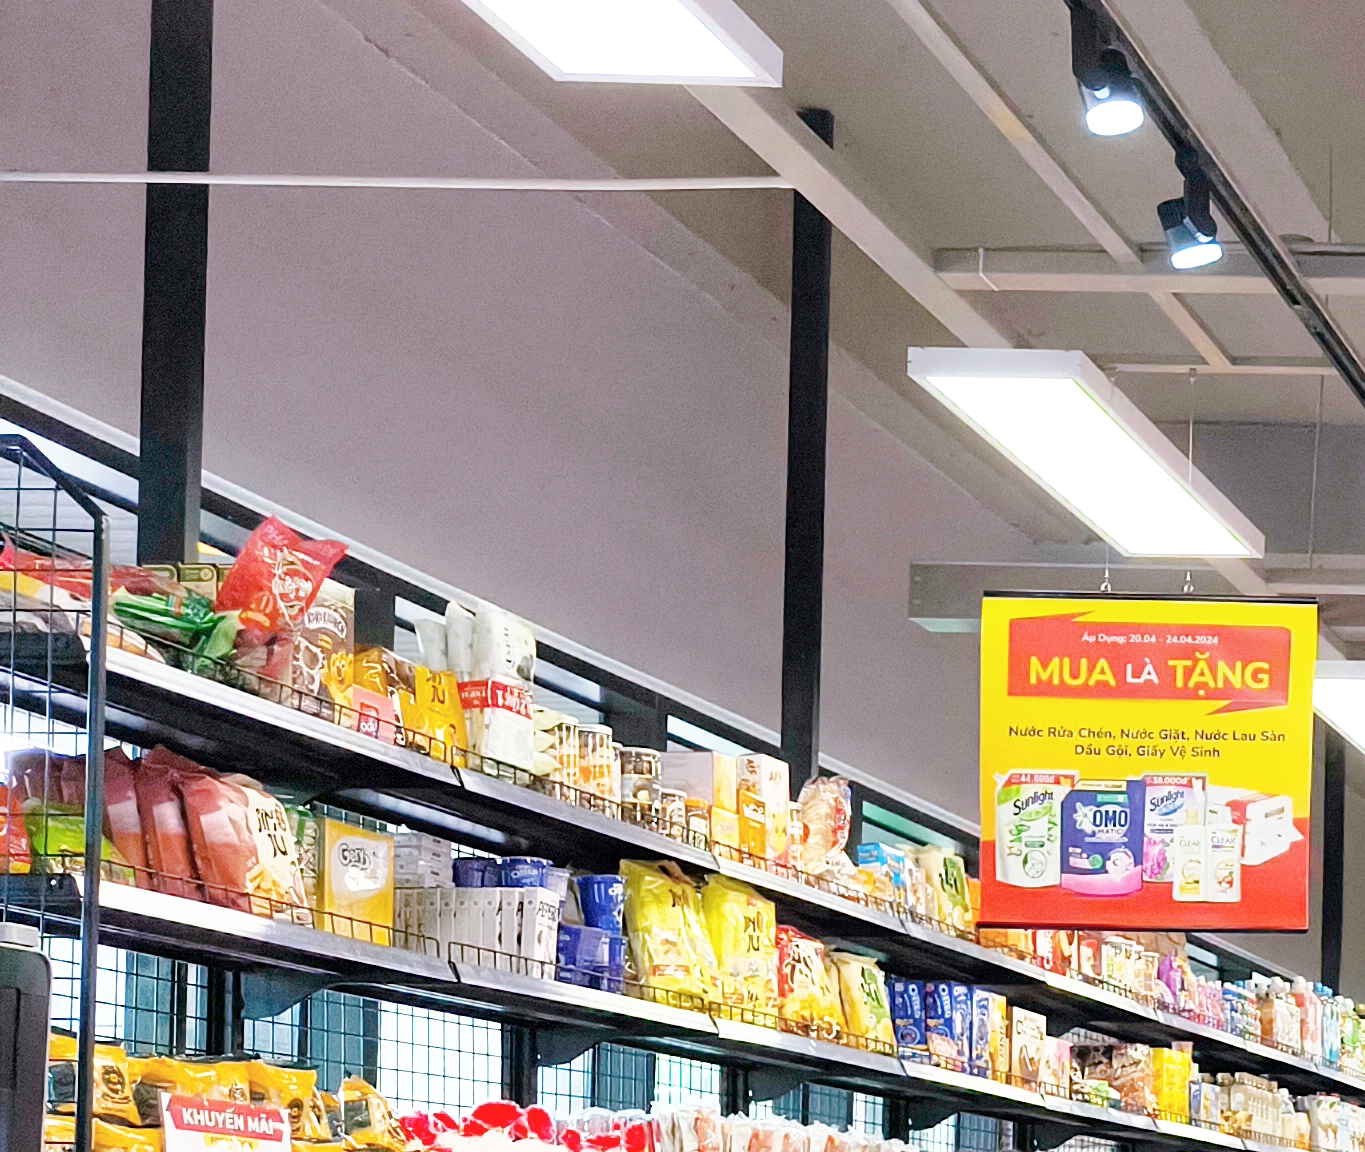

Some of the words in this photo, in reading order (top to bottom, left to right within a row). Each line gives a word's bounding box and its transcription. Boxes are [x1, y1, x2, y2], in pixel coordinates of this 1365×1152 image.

[1081, 631, 1096, 643] Áp
[1098, 633, 1127, 645] Dụng:
[1129, 634, 1156, 643] 20.04
[1166, 635, 1218, 645] 24.04.2024
[1029, 655, 1116, 687] MUA
[1126, 658, 1159, 684] LÀ
[1168, 651, 1270, 696] TẶNG
[1009, 726, 1043, 738] Nước
[1048, 726, 1073, 738] Rửa
[1079, 727, 1116, 740] Chén,
[1120, 728, 1154, 740] Nước
[1159, 728, 1190, 743] Giặt,
[1195, 729, 1229, 741] Nước
[1233, 730, 1258, 741] Lau
[1261, 730, 1286, 742] Sàn
[1075, 744, 1101, 756] Dầu
[1105, 745, 1132, 759] Gội,
[1136, 745, 1165, 759] Giấy
[1170, 746, 1187, 759] Vệ
[1191, 746, 1221, 758] Sinh
[1013, 791, 1054, 816] Sunlight
[1149, 791, 1185, 812] Sunlight
[1092, 809, 1128, 829] OMO
[1211, 835, 1236, 846] CLEAR
[182, 1107, 245, 1132] KHUYẾN
[246, 1113, 275, 1135] MÃI
